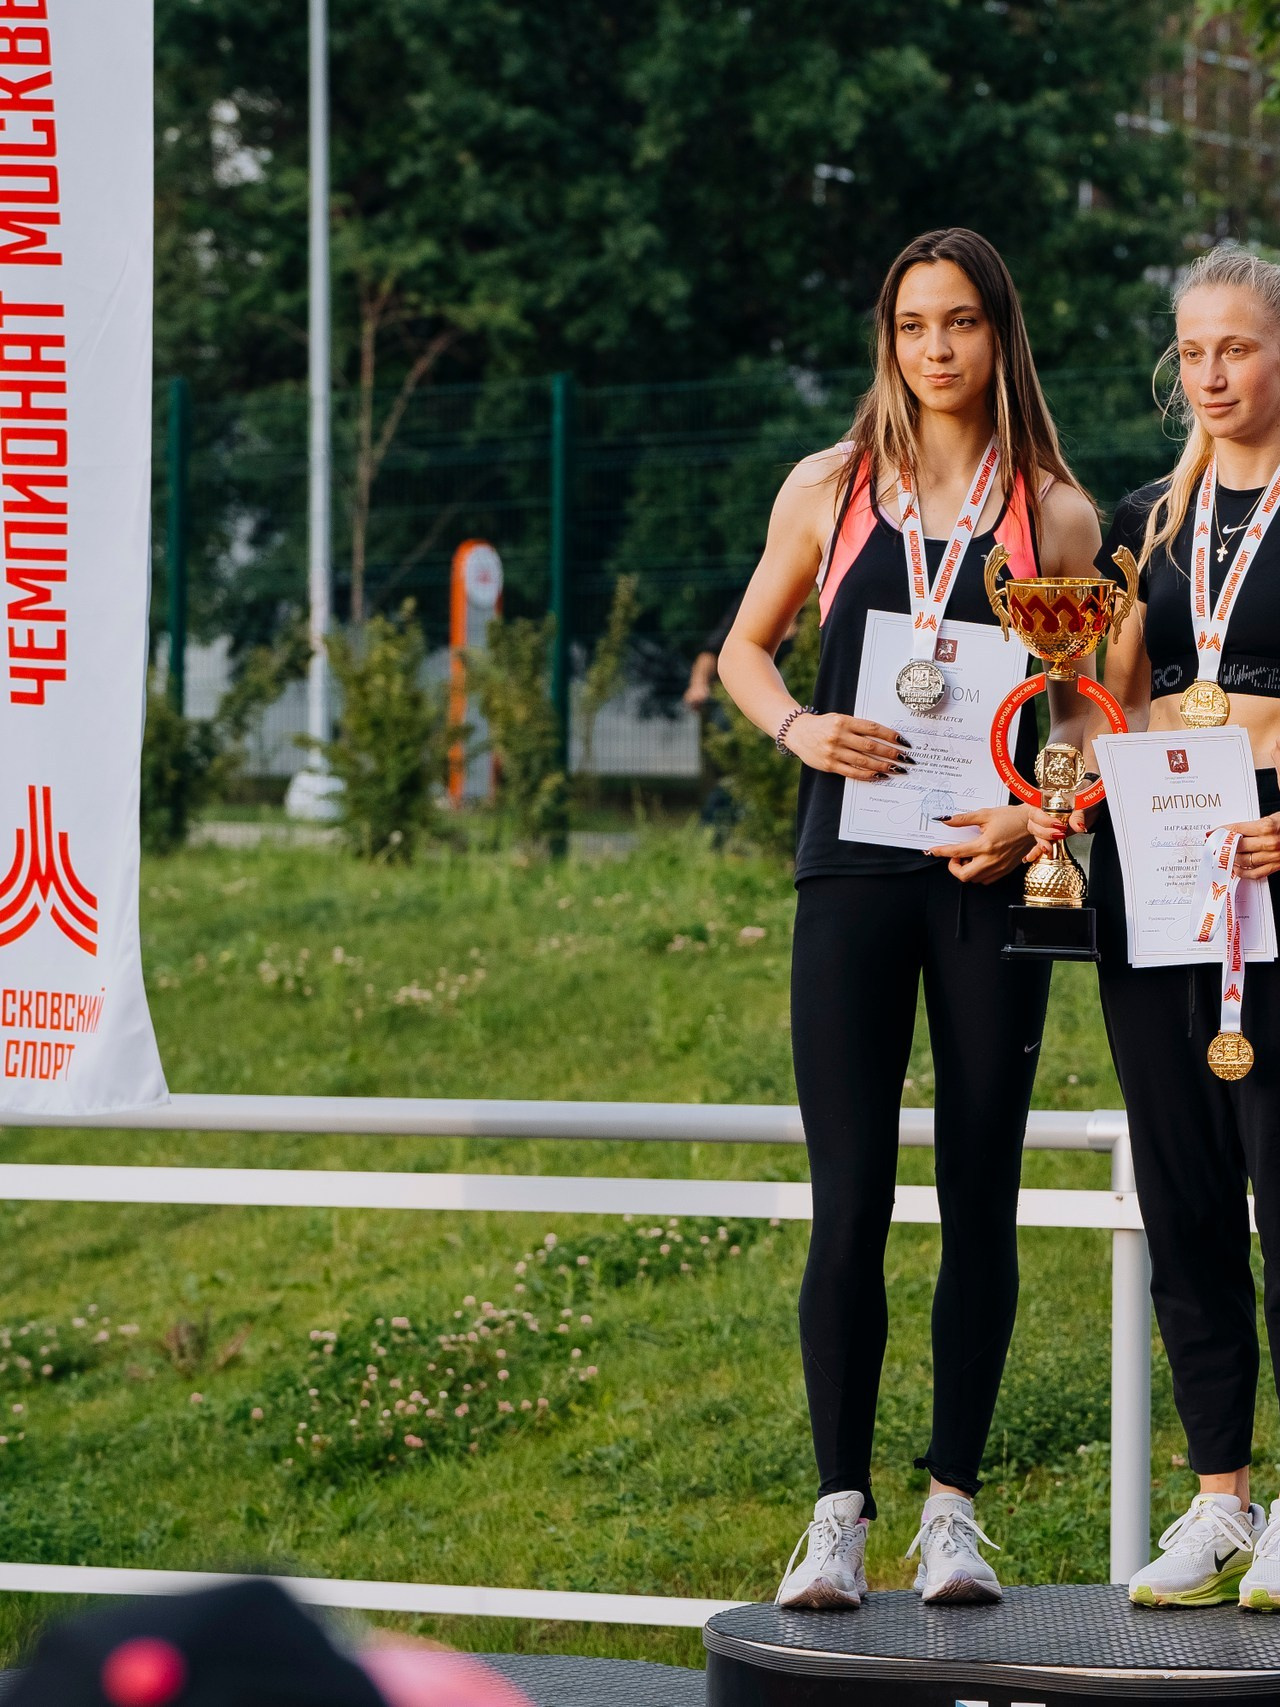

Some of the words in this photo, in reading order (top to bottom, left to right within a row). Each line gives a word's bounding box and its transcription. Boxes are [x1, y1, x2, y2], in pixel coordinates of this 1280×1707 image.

[970, 464, 992, 506] МОСКОВСКИЙ
[985, 446, 999, 468] СПОРТ
[0, 290, 68, 706] ЧЕМПИОНАТ
[908, 530, 925, 576] МОСКОВСКИЙ
[913, 574, 925, 599] СПОРТ
[933, 558, 956, 603] МОСКОВСКИЙ
[951, 539, 964, 560] СПОРТ
[1195, 547, 1207, 597] МОСКОВСКИЙ
[1216, 572, 1242, 621] МОСКОВСКИЙ
[1236, 549, 1251, 573] СПОРТ
[1196, 595, 1206, 618] СПОРТ
[1011, 682, 1037, 703] МОСКВЫ
[1086, 686, 1122, 725] ДЕПАРТАМЕНТ
[998, 703, 1014, 729] ГОРОДА
[996, 730, 1004, 757] СПОРТА
[1083, 786, 1105, 803] ОСКВЫ
[1152, 793, 1222, 813] ДИПЛОМ
[1218, 846, 1232, 871] СПОРТ
[5, 1040, 75, 1081] СПОРТ
